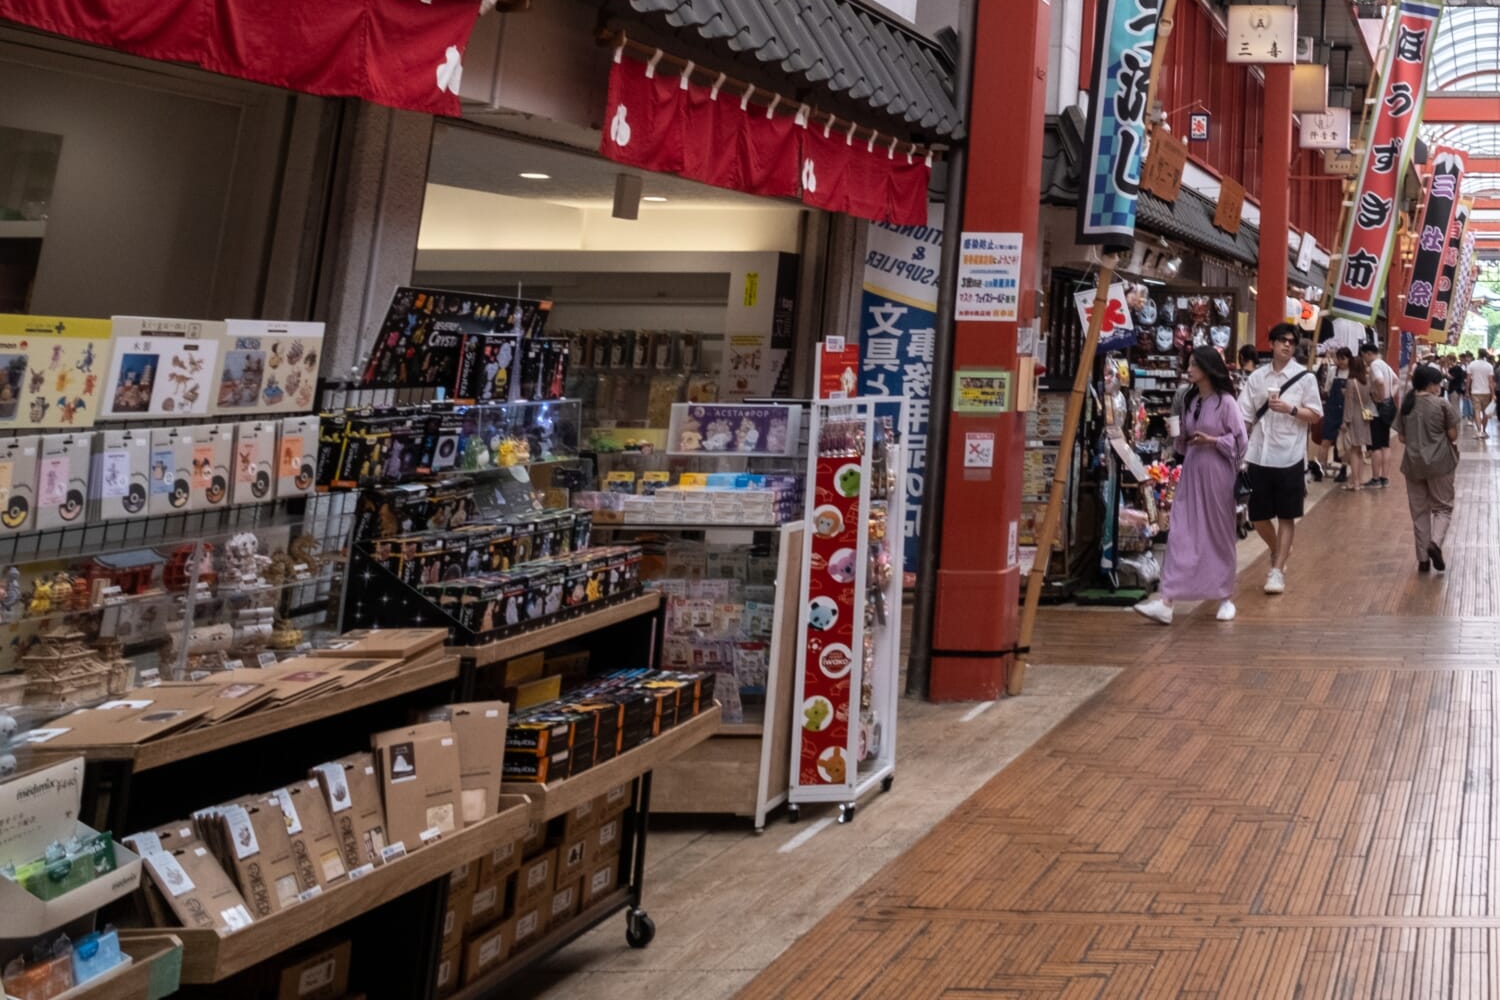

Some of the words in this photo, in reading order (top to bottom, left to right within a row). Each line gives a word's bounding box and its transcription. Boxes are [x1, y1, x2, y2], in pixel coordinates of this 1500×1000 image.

[1343, 26, 1427, 289] ほうずき市
[1407, 174, 1457, 308] 三社祭
